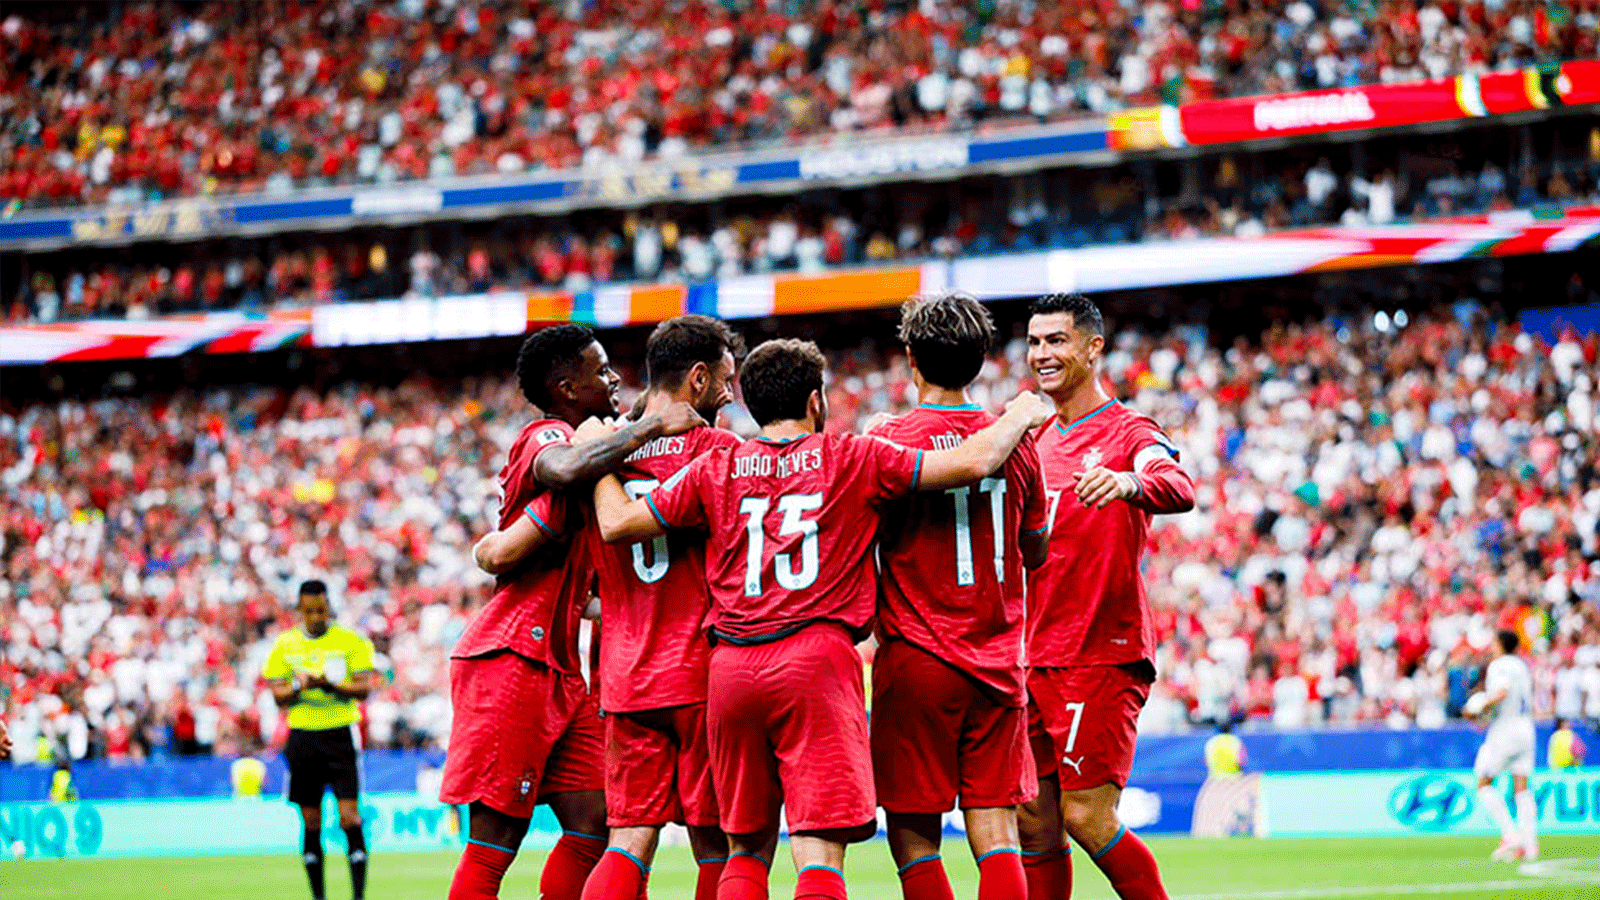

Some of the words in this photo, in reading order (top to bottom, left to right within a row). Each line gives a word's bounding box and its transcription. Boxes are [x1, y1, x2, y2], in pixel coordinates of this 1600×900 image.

[731, 453, 771, 478] JOÃO
[776, 448, 822, 478] NEVES
[739, 492, 823, 597] 15
[944, 477, 1007, 586] 11
[1065, 702, 1085, 753] 7
[74, 806, 102, 856] 9
